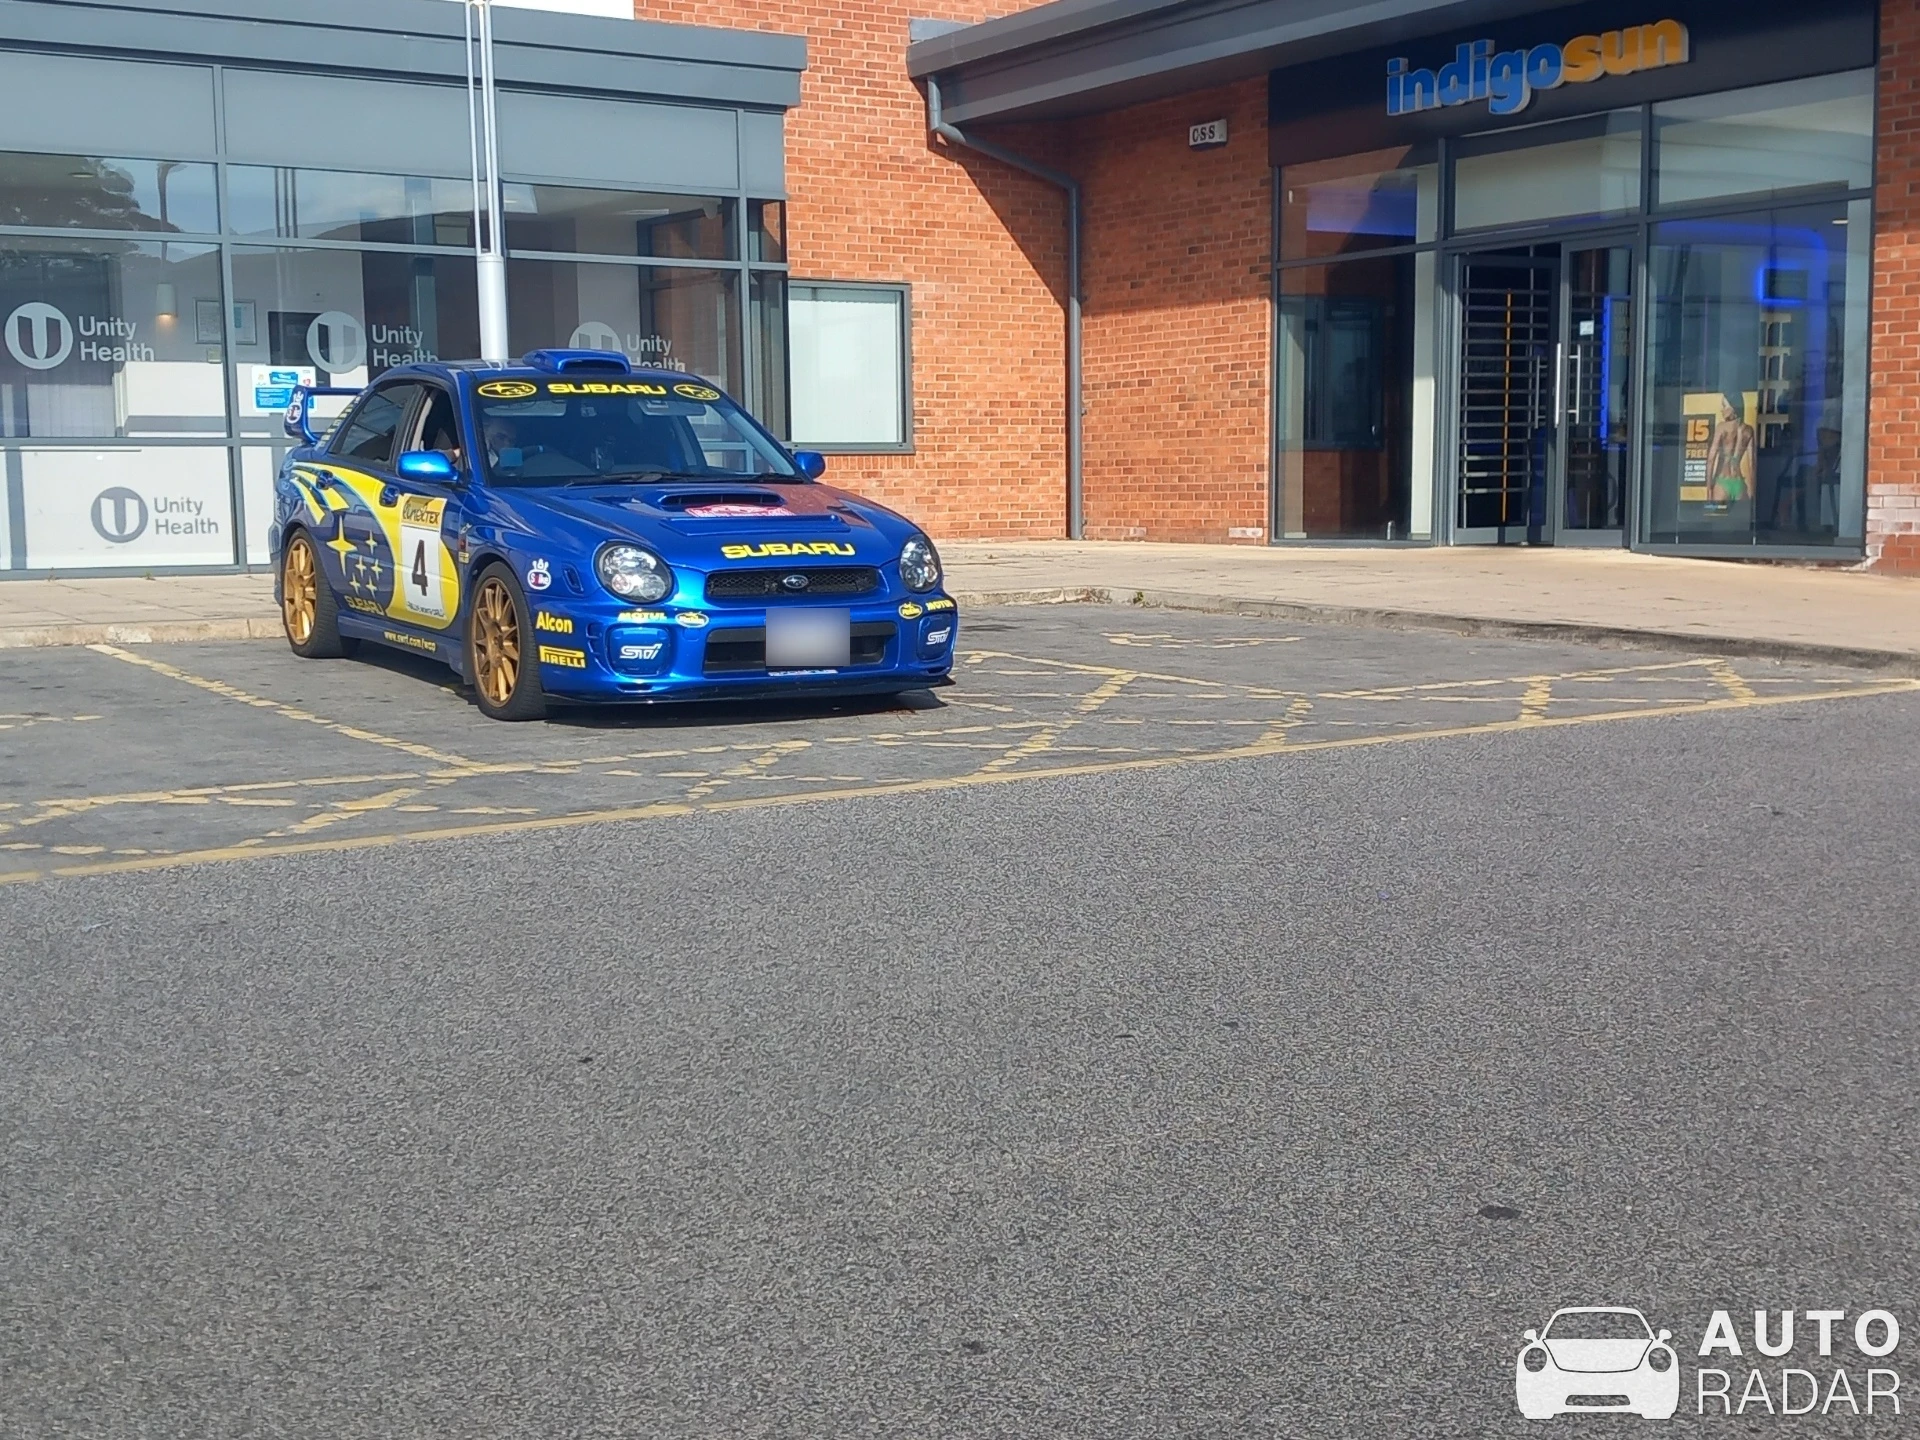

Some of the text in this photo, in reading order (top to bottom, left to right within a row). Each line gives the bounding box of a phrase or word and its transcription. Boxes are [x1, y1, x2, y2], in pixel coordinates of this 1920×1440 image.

[1386, 19, 1690, 116] indigosun
[78, 315, 137, 341] Unity
[371, 324, 424, 349] Unity
[79, 342, 155, 363] Health
[626, 333, 673, 356] Unity
[546, 381, 668, 396] SUBARU
[1686, 419, 1710, 442] 15
[1685, 449, 1708, 459] FREE
[153, 496, 204, 516] Unity
[154, 517, 219, 536] Health
[720, 542, 856, 560] SUBARU
[411, 539, 429, 597] 4
[535, 611, 573, 634] Alcon
[538, 645, 586, 669] PIRELLI
